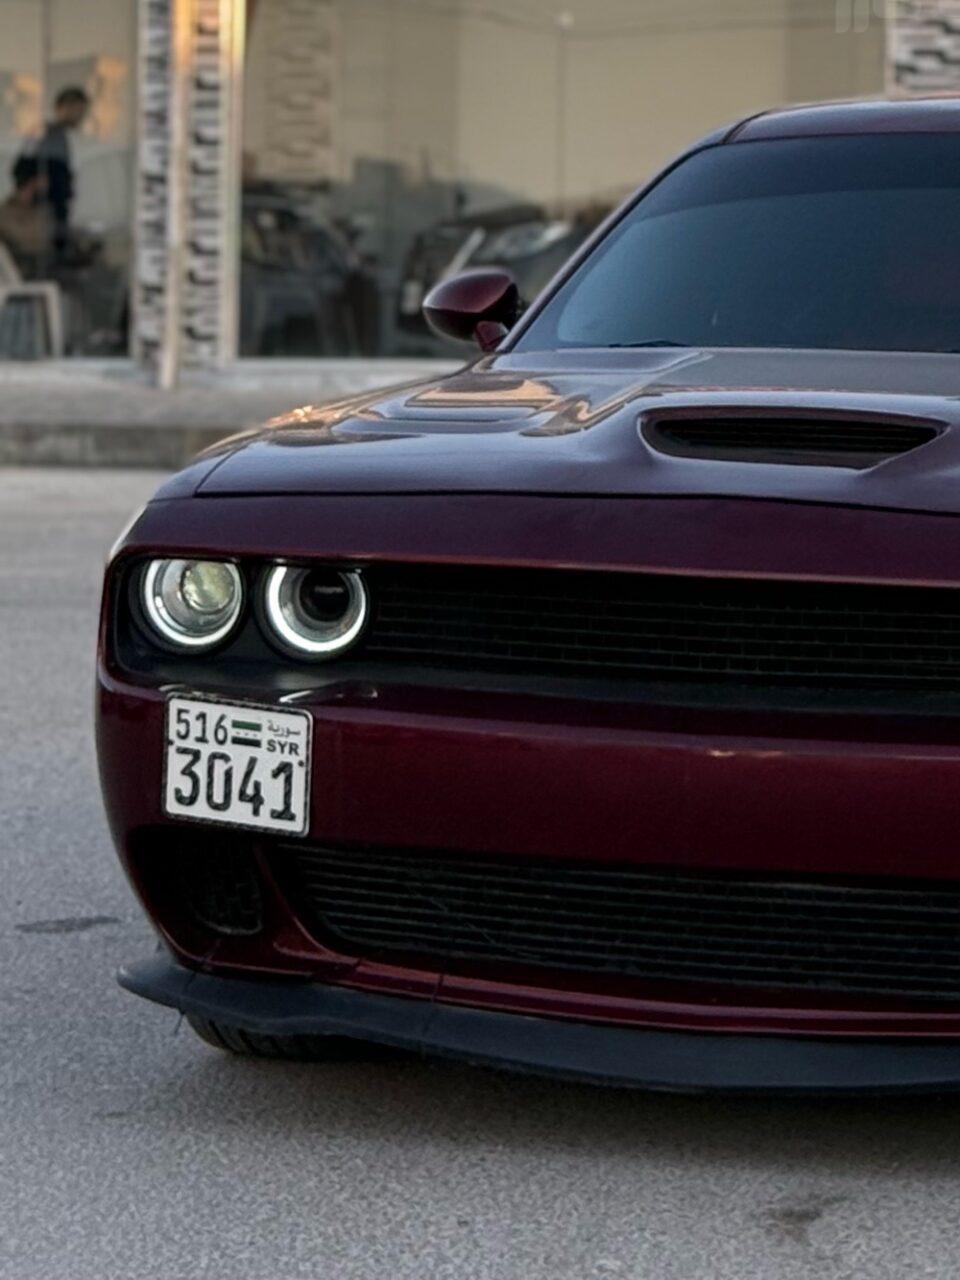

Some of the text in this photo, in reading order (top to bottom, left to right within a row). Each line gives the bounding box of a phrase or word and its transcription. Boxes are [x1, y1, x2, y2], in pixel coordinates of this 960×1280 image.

[175, 707, 229, 746] 516
[266, 720, 301, 738] سورية
[266, 738, 300, 757] SYR
[174, 745, 297, 822] 3041
